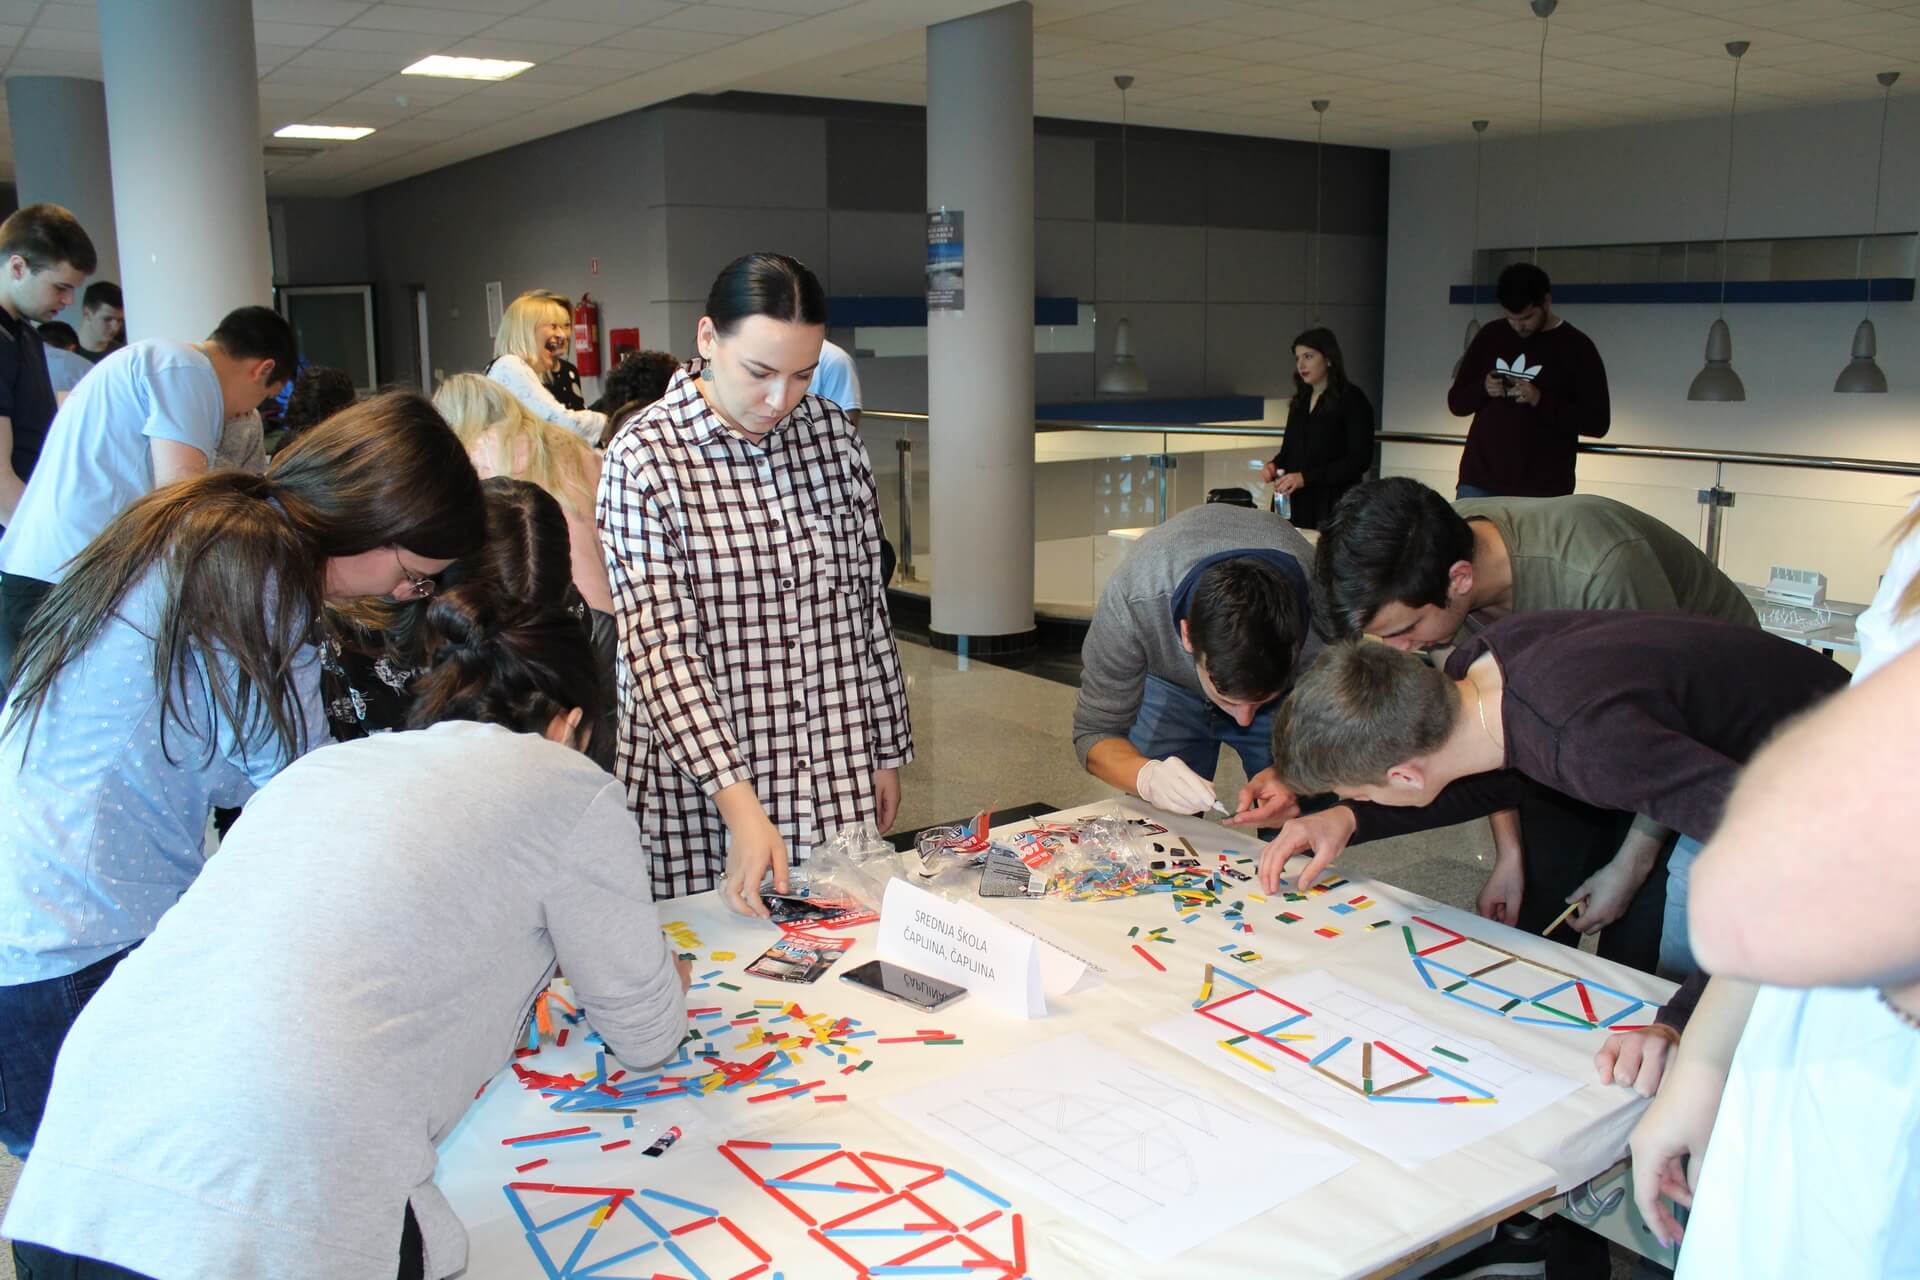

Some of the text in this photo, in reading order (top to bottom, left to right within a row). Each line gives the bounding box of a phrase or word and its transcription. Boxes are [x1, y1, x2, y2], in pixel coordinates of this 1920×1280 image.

[915, 909, 955, 938] SREDNJA
[957, 927, 987, 952] ŠKOLA
[950, 949, 996, 981] ČAPLJINA
